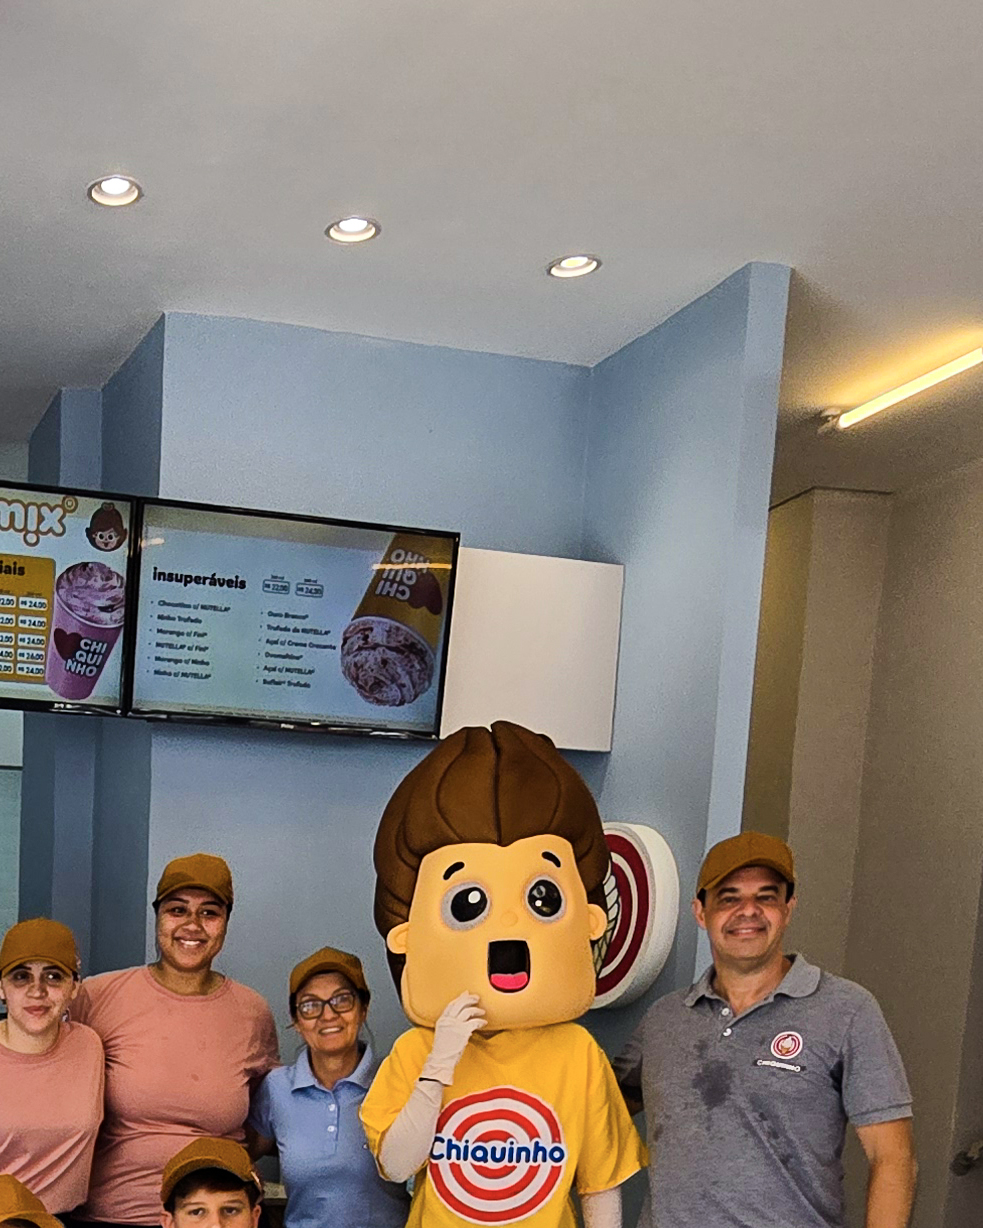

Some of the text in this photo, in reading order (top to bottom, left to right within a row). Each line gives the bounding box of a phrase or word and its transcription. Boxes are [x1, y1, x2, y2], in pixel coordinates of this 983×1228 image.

[153, 566, 247, 590] insuperáveis
[375, 580, 411, 600] CHI
[79, 638, 108, 654] CHI
[65, 658, 97, 677] NHO
[75, 650, 103, 666] QUI
[429, 1136, 565, 1164] Chiquinho
